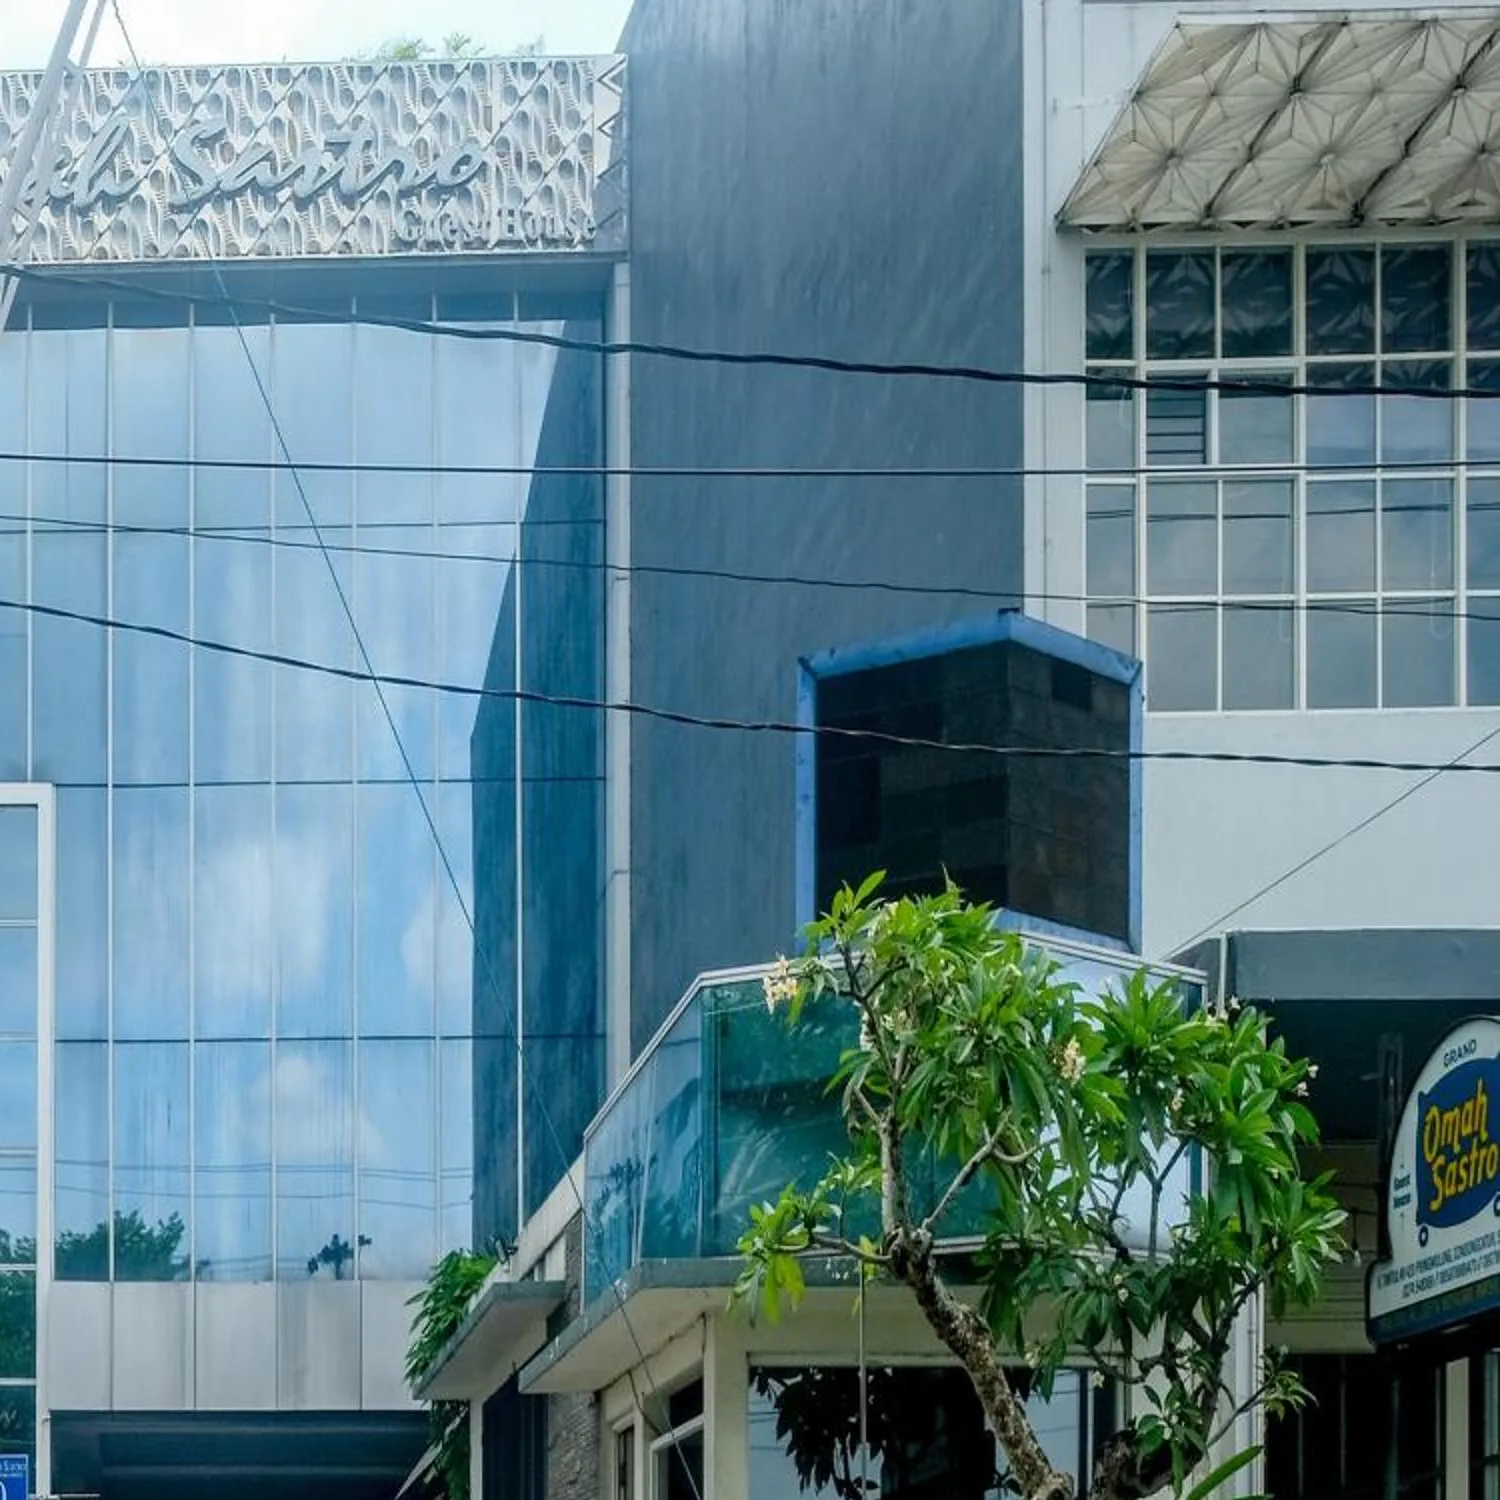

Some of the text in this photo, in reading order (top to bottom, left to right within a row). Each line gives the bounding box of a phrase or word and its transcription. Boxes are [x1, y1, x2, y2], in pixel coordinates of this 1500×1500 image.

[1443, 1039, 1477, 1068] GRAND
[1423, 1076, 1488, 1164] Omah
[1429, 1136, 1500, 1213] Sastro
